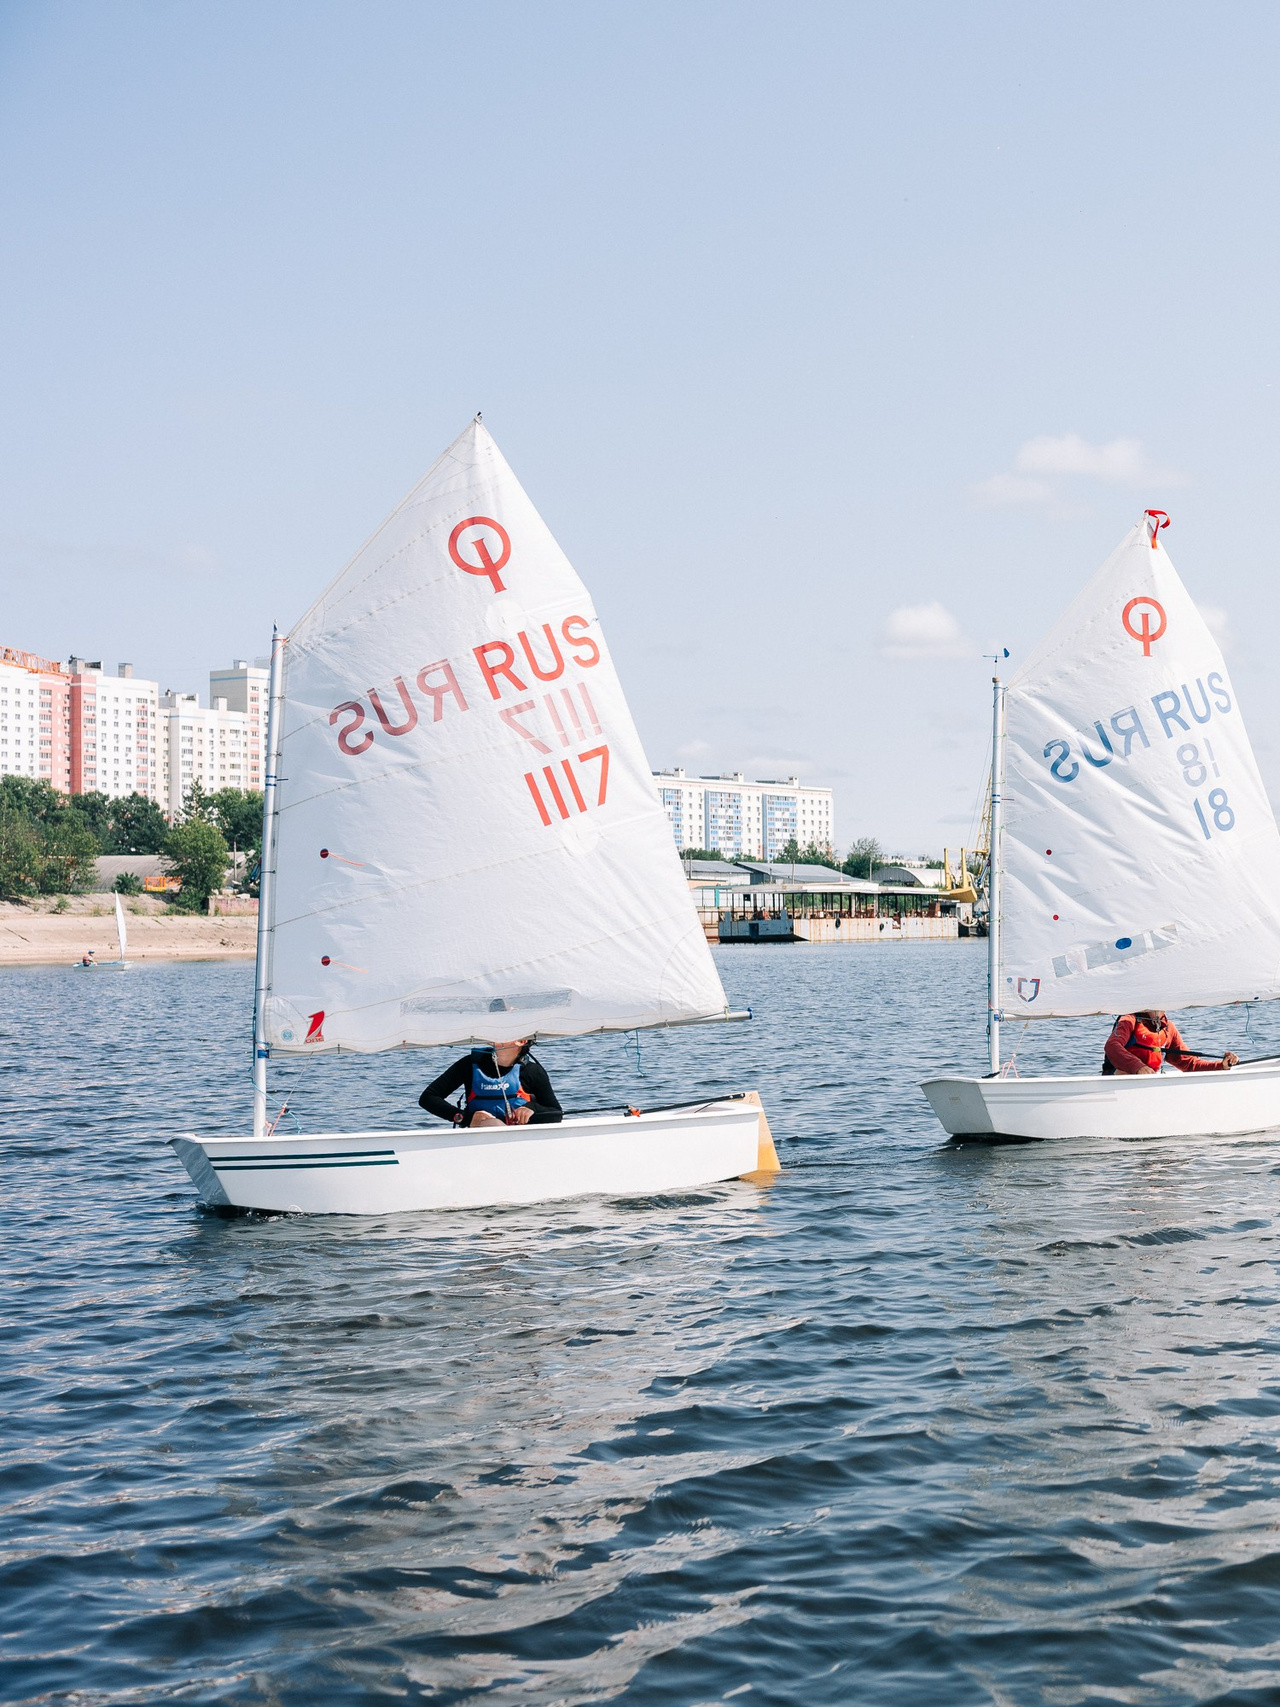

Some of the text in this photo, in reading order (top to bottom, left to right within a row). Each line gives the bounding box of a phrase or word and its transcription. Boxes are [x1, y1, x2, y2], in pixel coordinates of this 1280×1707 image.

[472, 615, 600, 700] RUS
[1151, 671, 1232, 739] RUS
[523, 744, 610, 827] 1117
[1193, 787, 1236, 840] 18
